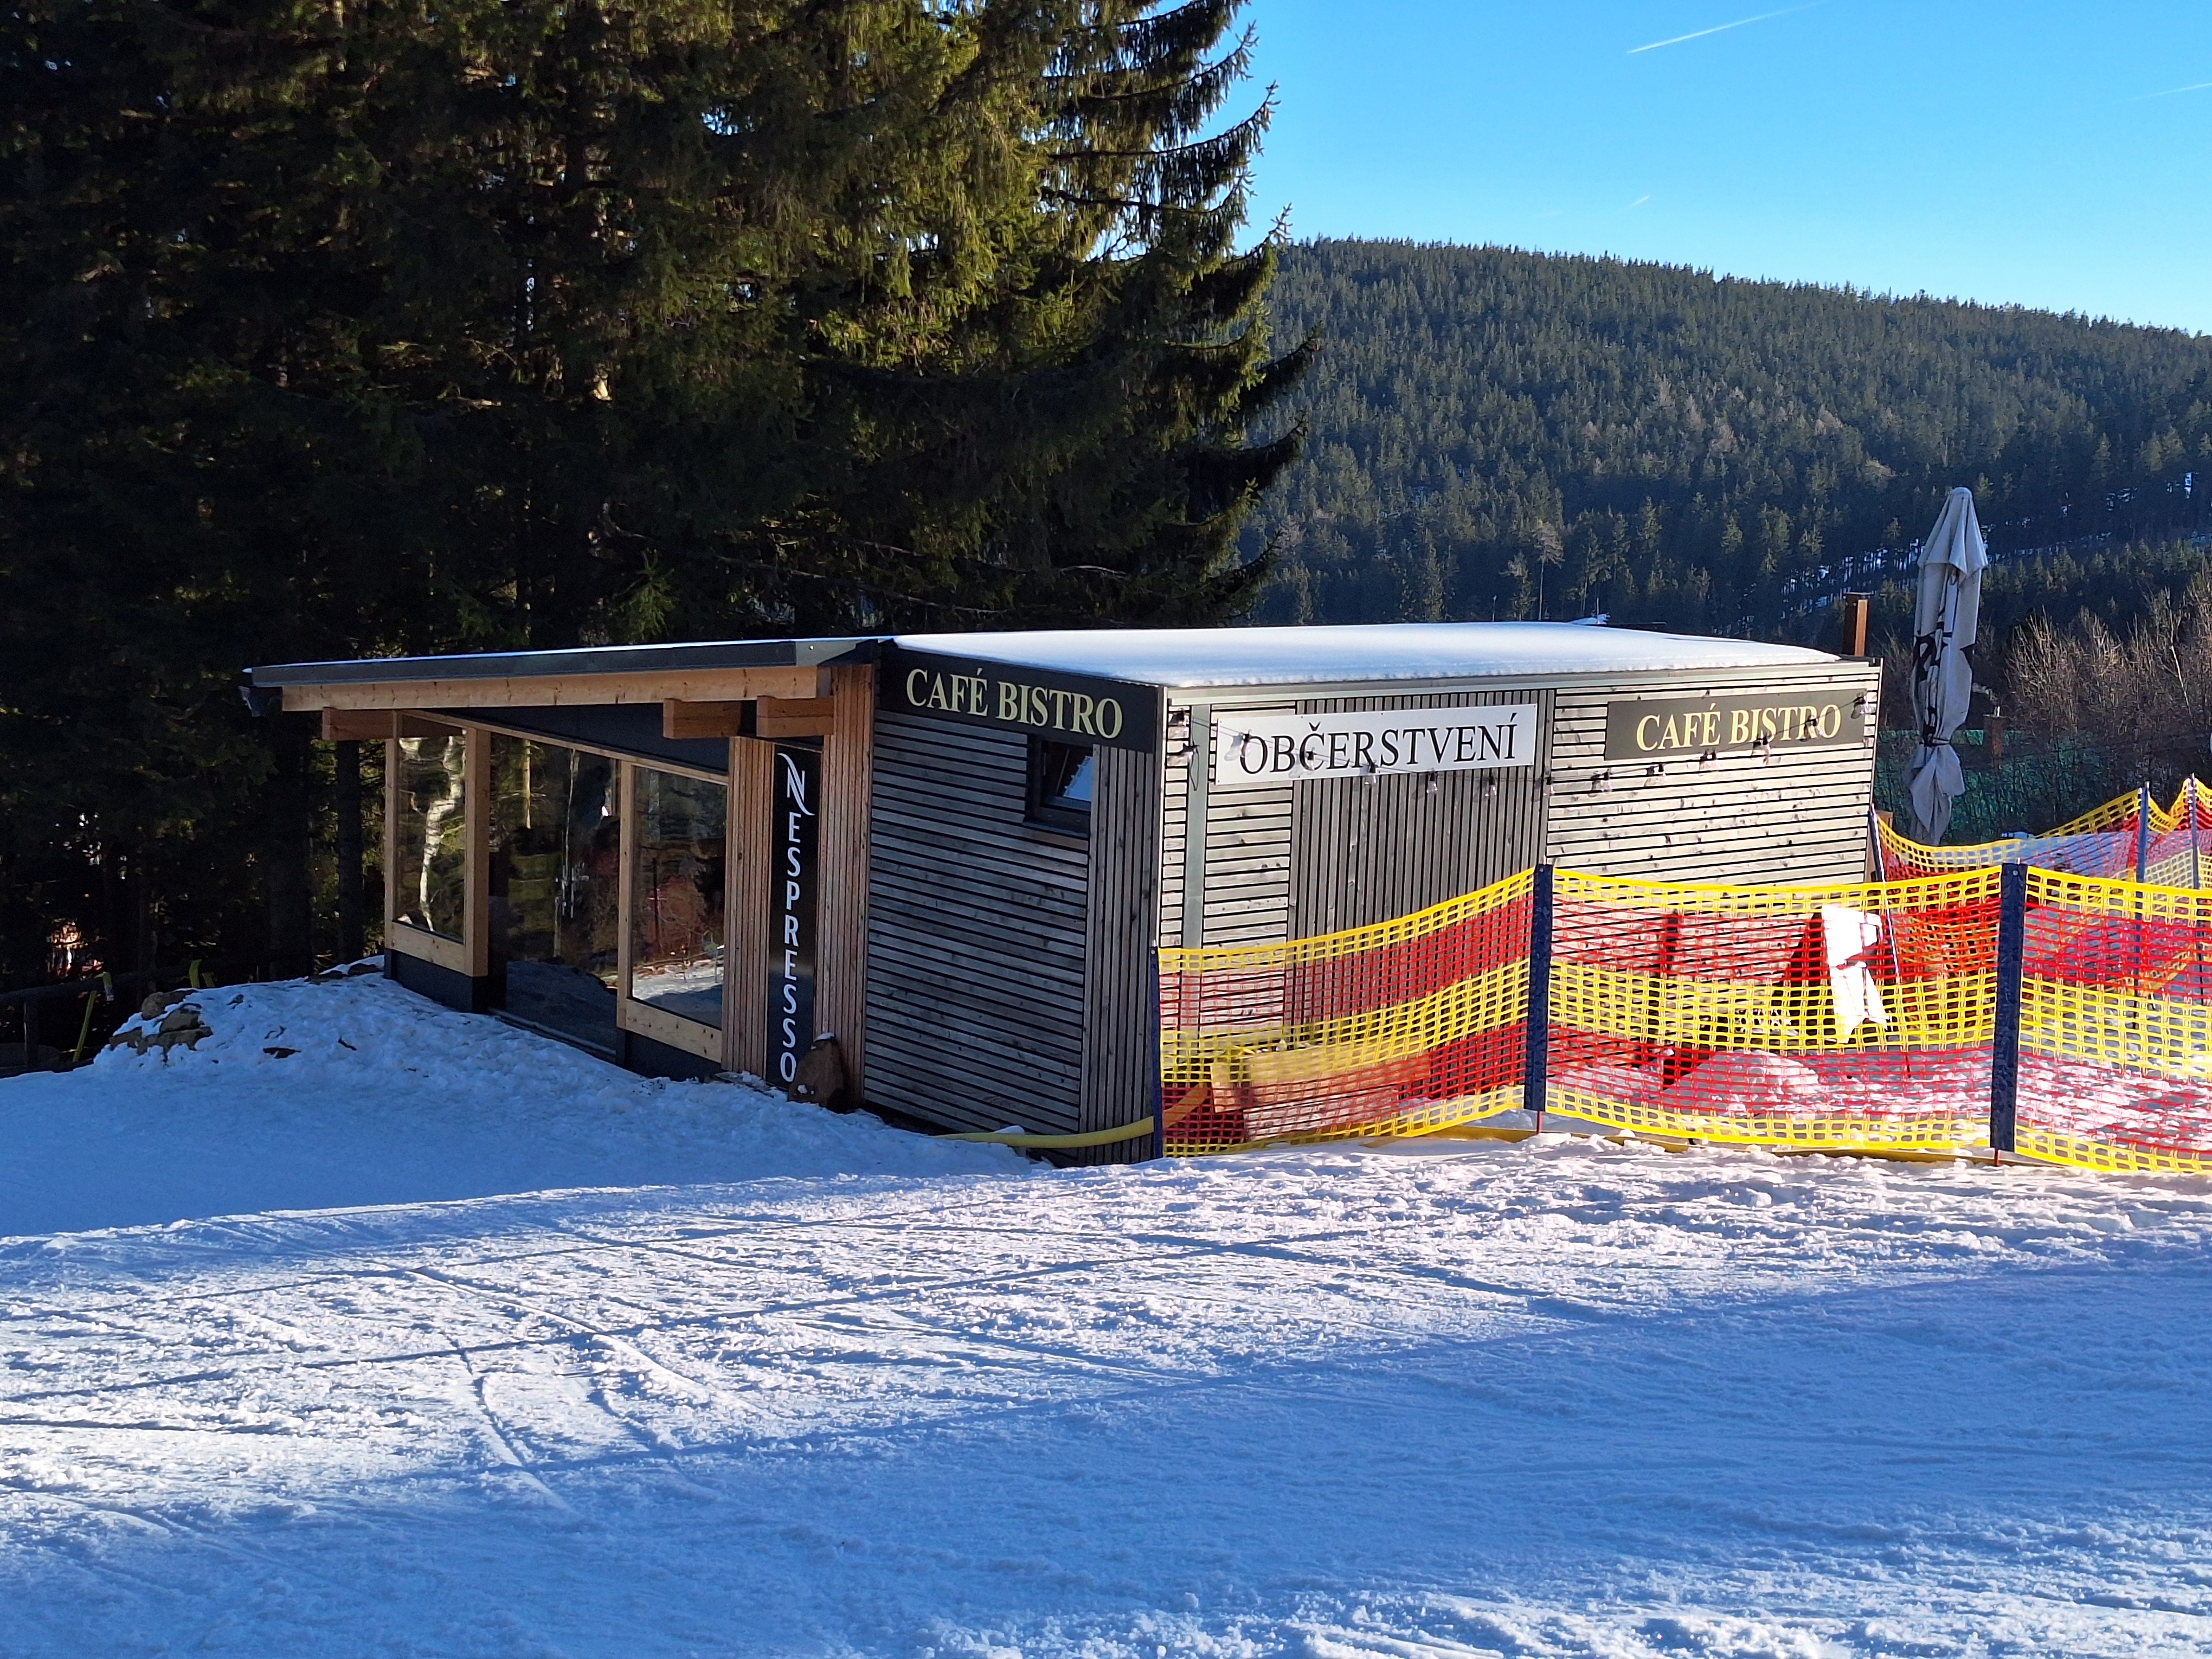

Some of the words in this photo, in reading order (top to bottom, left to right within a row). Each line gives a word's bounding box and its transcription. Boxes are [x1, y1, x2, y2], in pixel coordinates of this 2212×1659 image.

[906, 668, 987, 716] CAFÉ
[996, 681, 1122, 738] BISTRO
[1636, 704, 1720, 751] CAFÉ
[1728, 705, 1841, 744] BISTRO
[1240, 712, 1517, 774] OBČERSTVENÍ
[777, 753, 815, 1082] NESPRESSO
